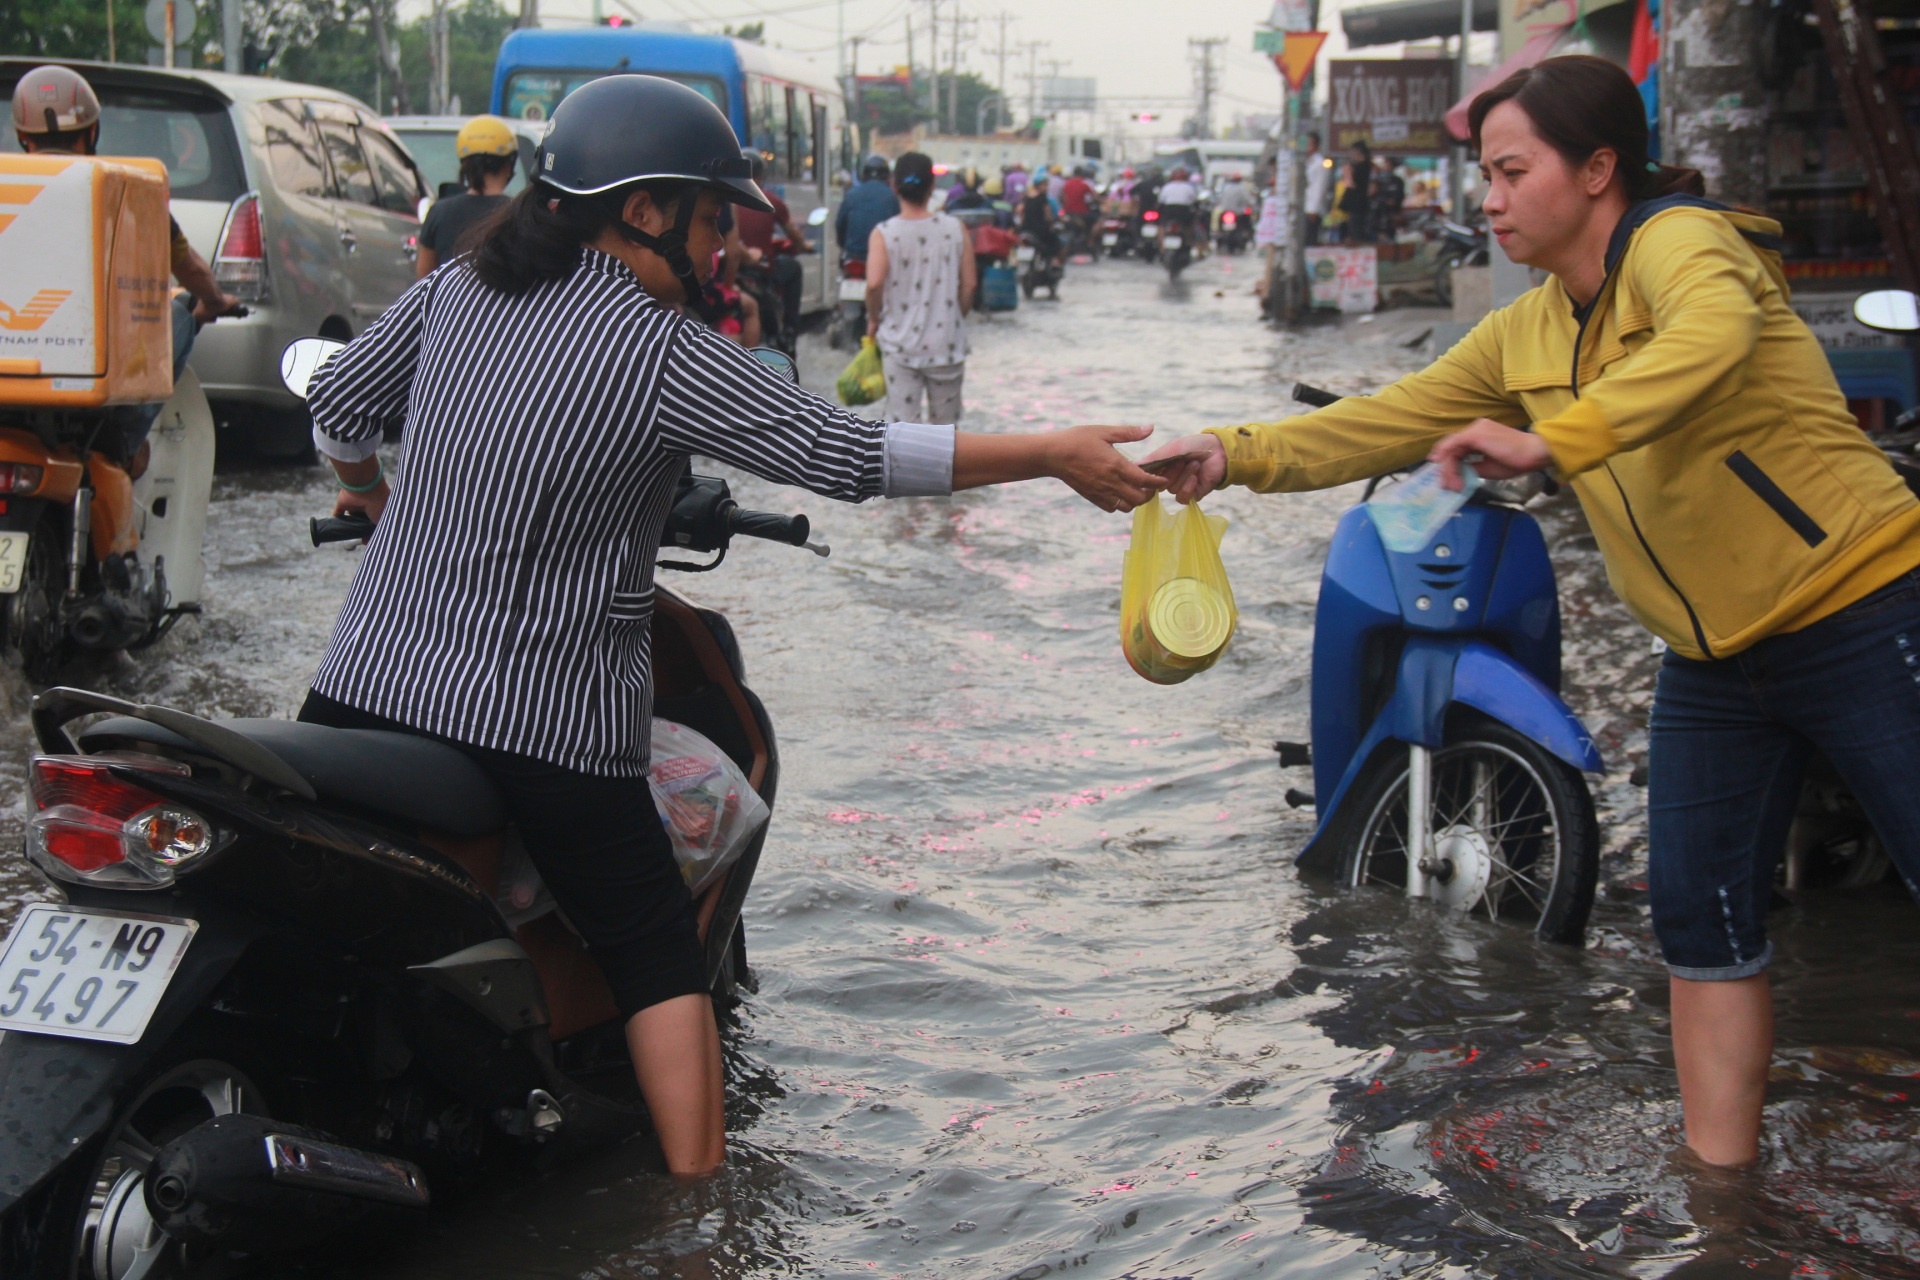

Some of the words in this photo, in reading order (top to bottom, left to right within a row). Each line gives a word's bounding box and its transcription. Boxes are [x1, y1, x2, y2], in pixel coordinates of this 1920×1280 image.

[45, 337, 86, 346] POST
[30, 915, 165, 973] 54-N9
[0, 968, 140, 1028] 5497
